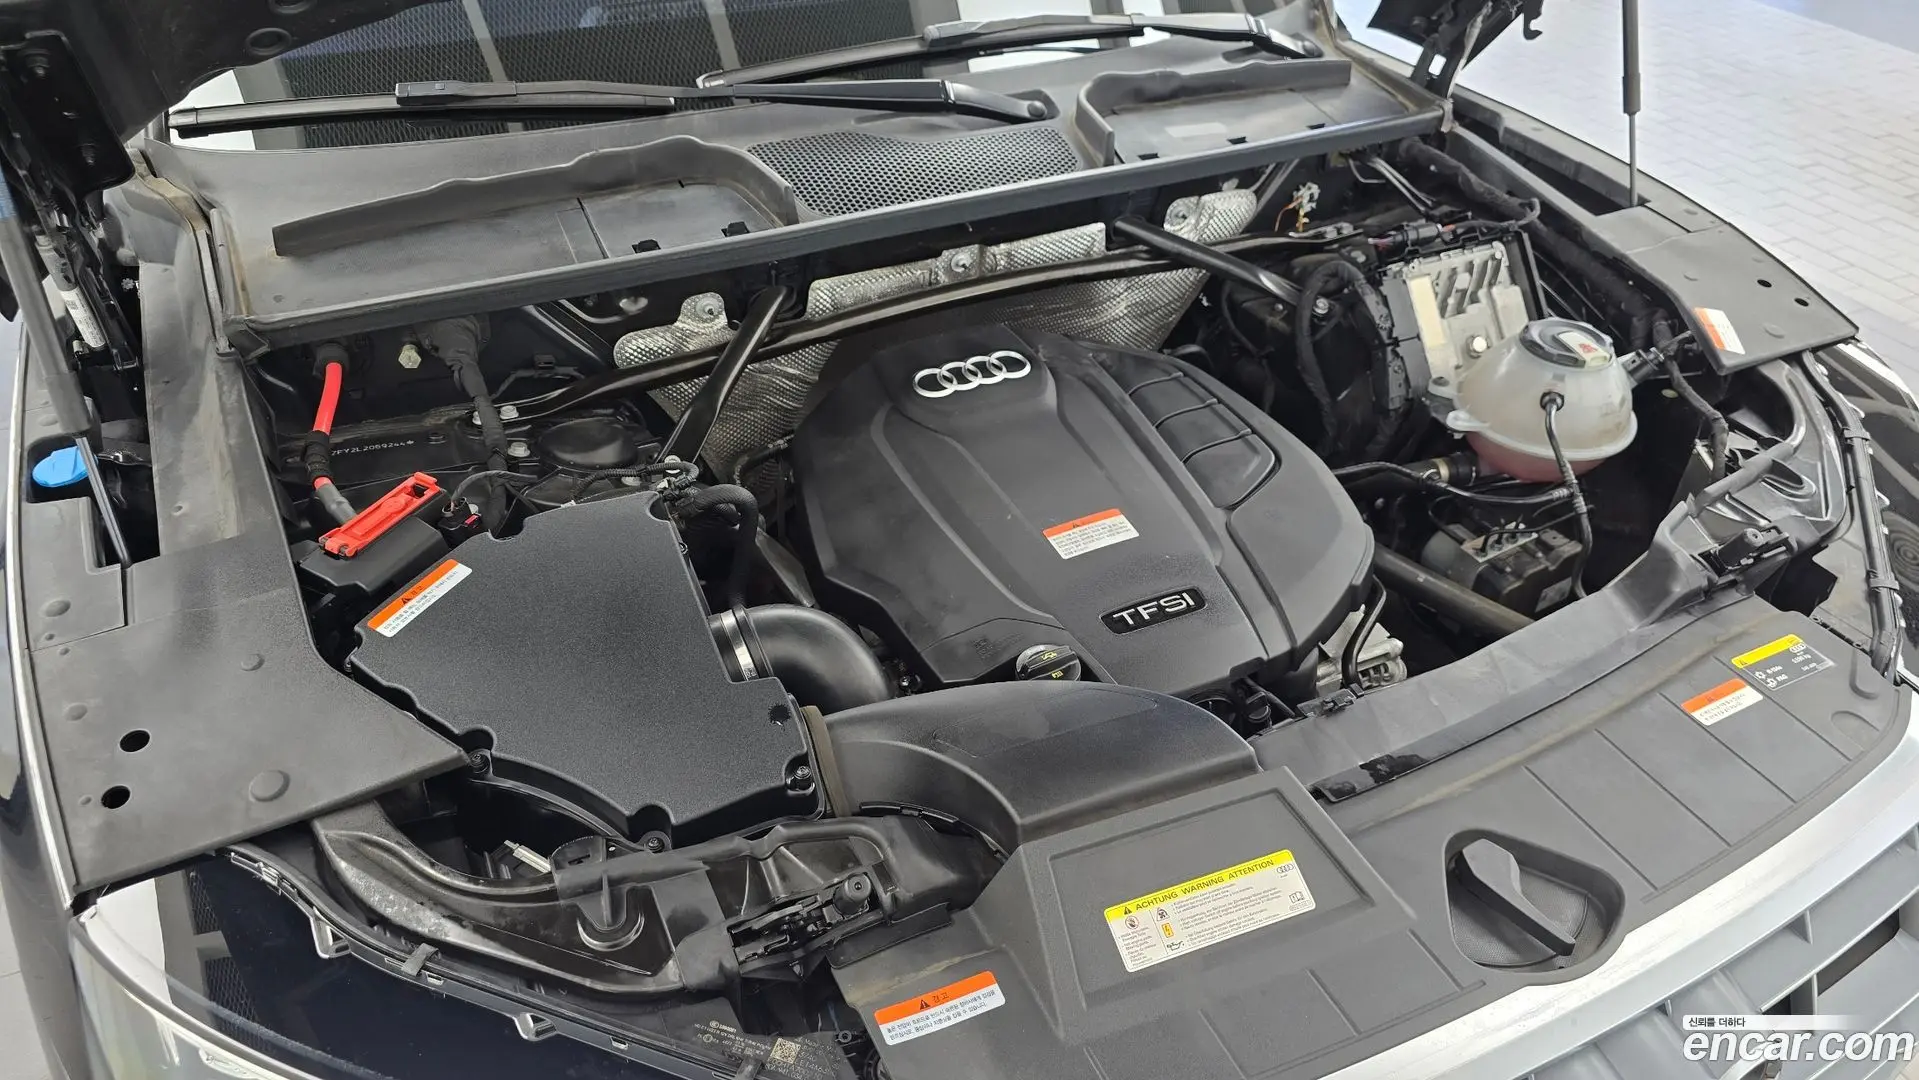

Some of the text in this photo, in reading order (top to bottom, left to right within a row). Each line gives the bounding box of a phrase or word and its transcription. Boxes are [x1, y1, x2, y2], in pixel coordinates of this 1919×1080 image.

[1112, 592, 1195, 625] TFSI
[1135, 891, 1178, 911] ACHTUNG
[1181, 876, 1224, 895] WARNING
[1228, 859, 1274, 880] ATTENTION
